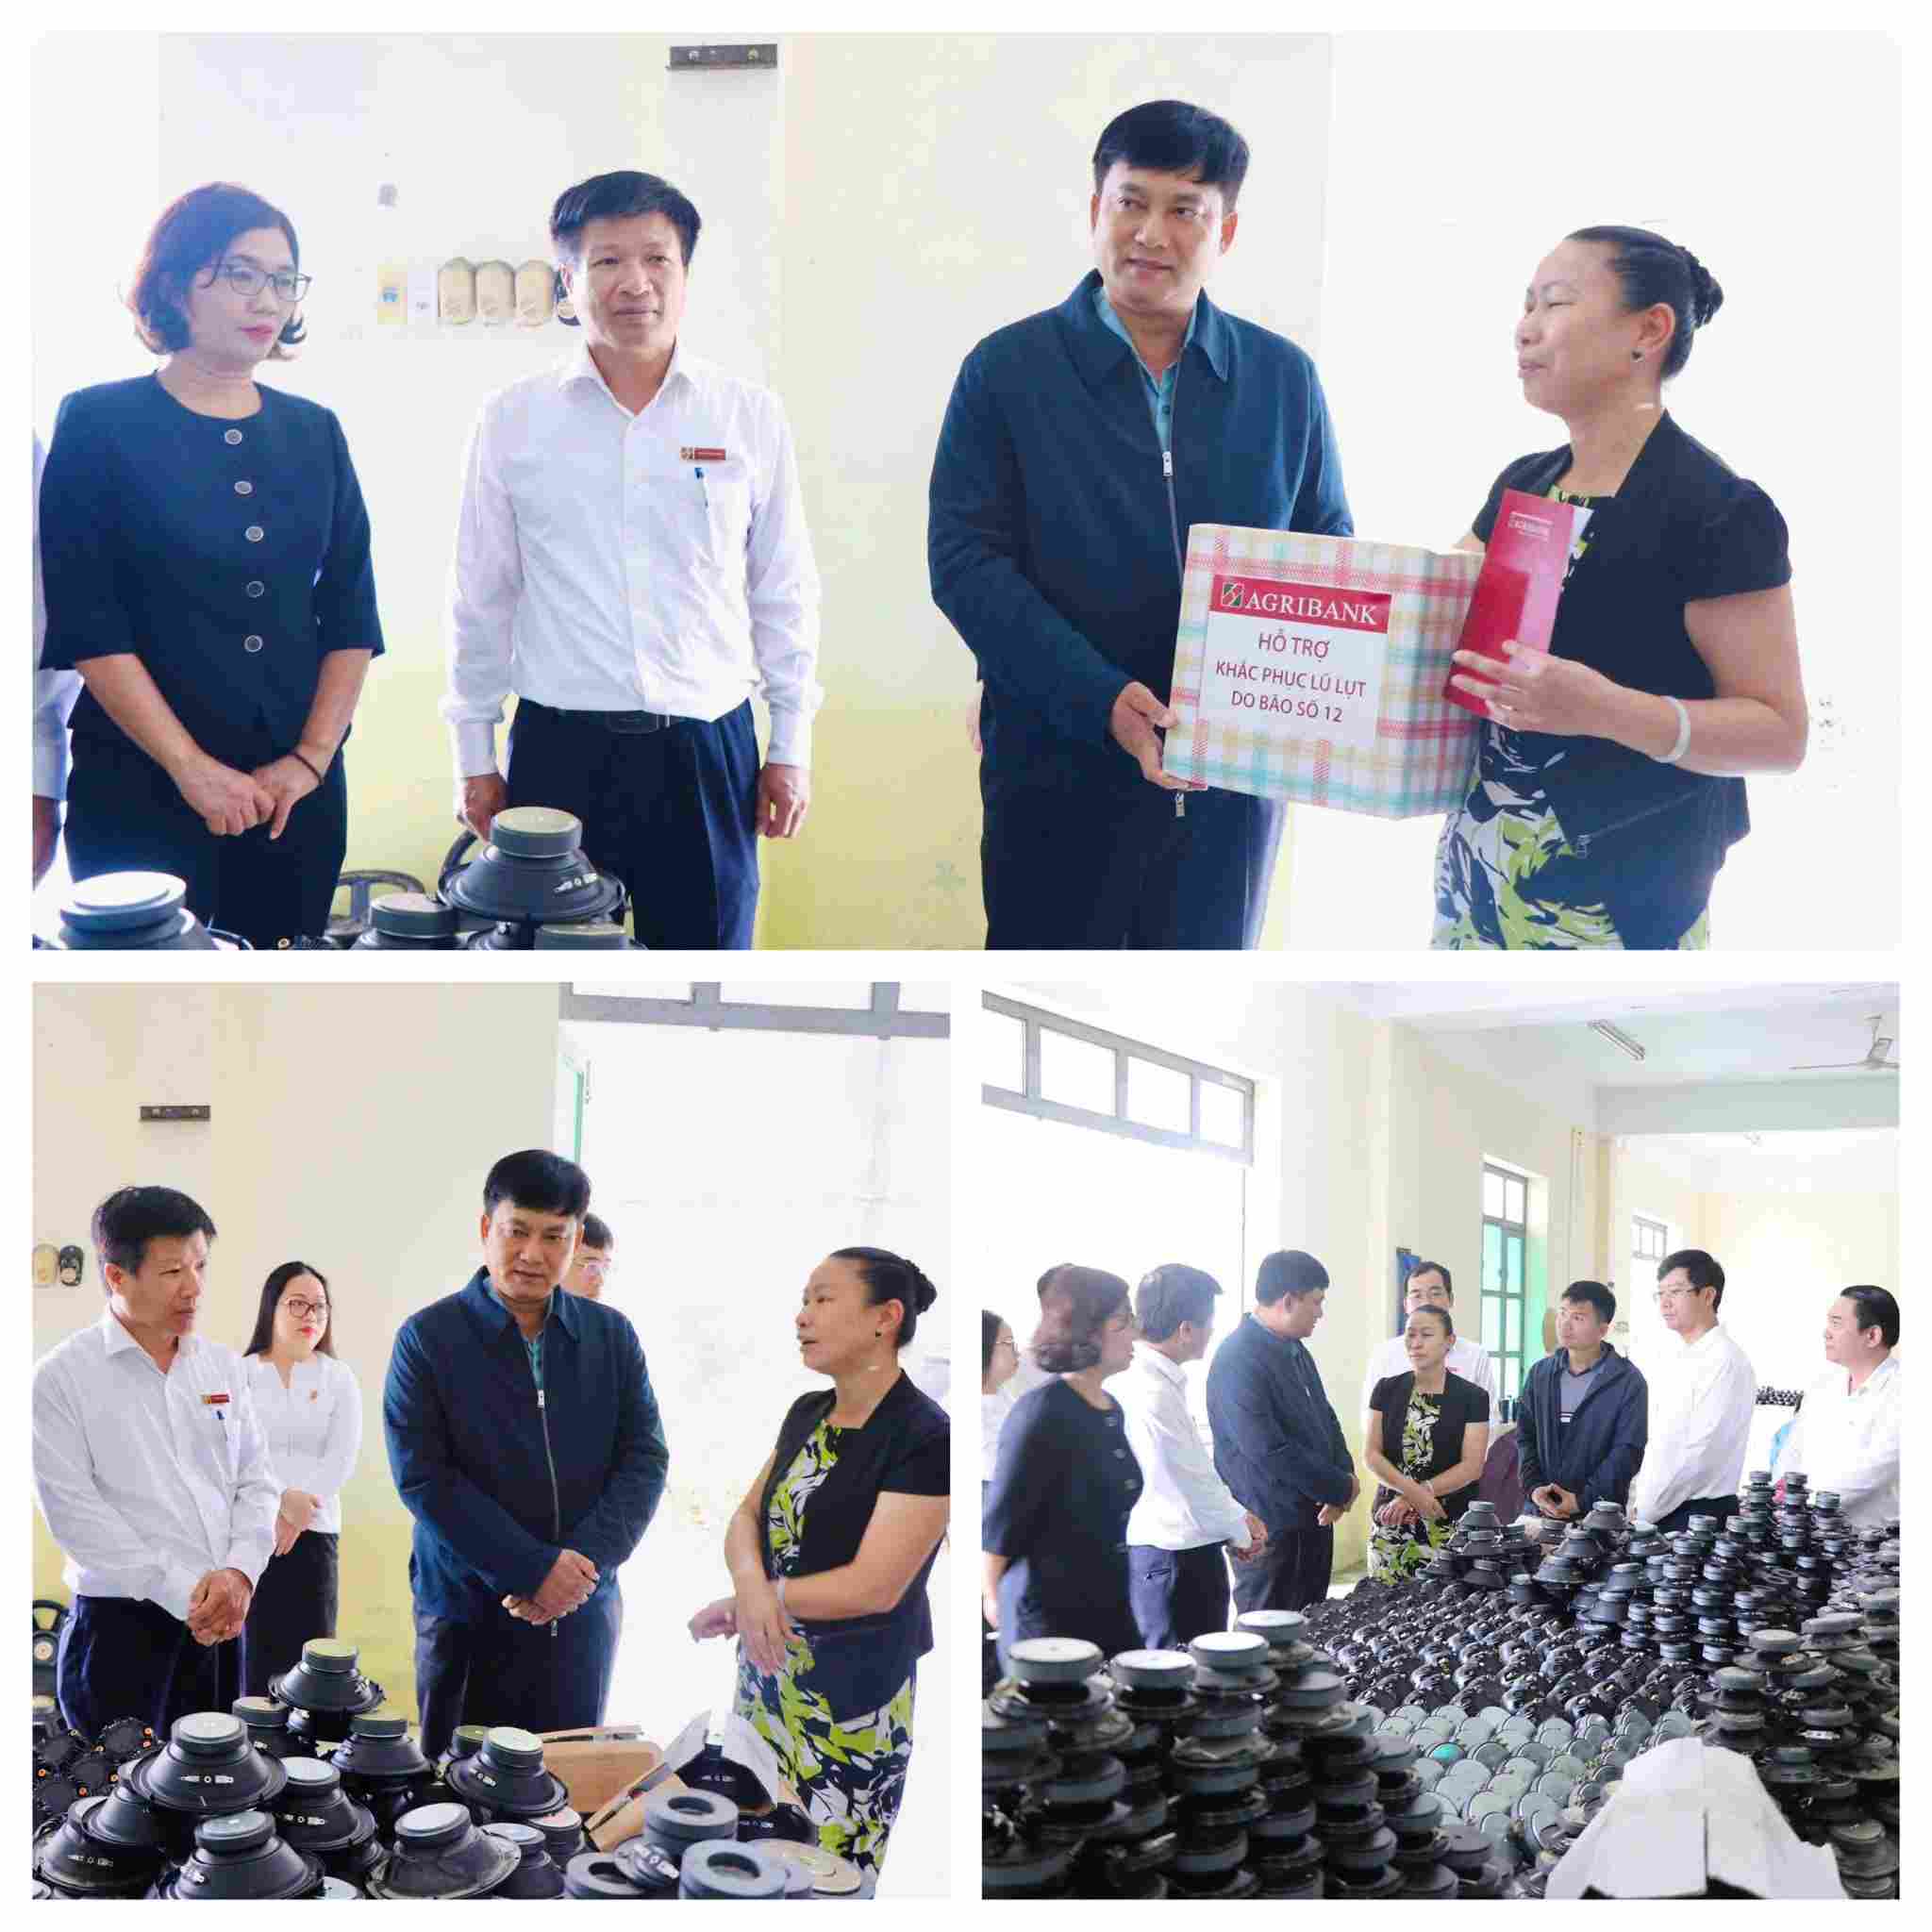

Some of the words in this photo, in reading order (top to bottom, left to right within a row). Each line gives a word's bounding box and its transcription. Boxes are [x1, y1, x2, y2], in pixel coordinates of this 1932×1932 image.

[1245, 590, 1378, 625] AGRIBANK
[1291, 637, 1330, 662] TRỢ
[1336, 678, 1366, 699] LỤT
[1231, 691, 1256, 708] DO
[1259, 693, 1292, 714] BÃO
[1324, 706, 1343, 723] 12
